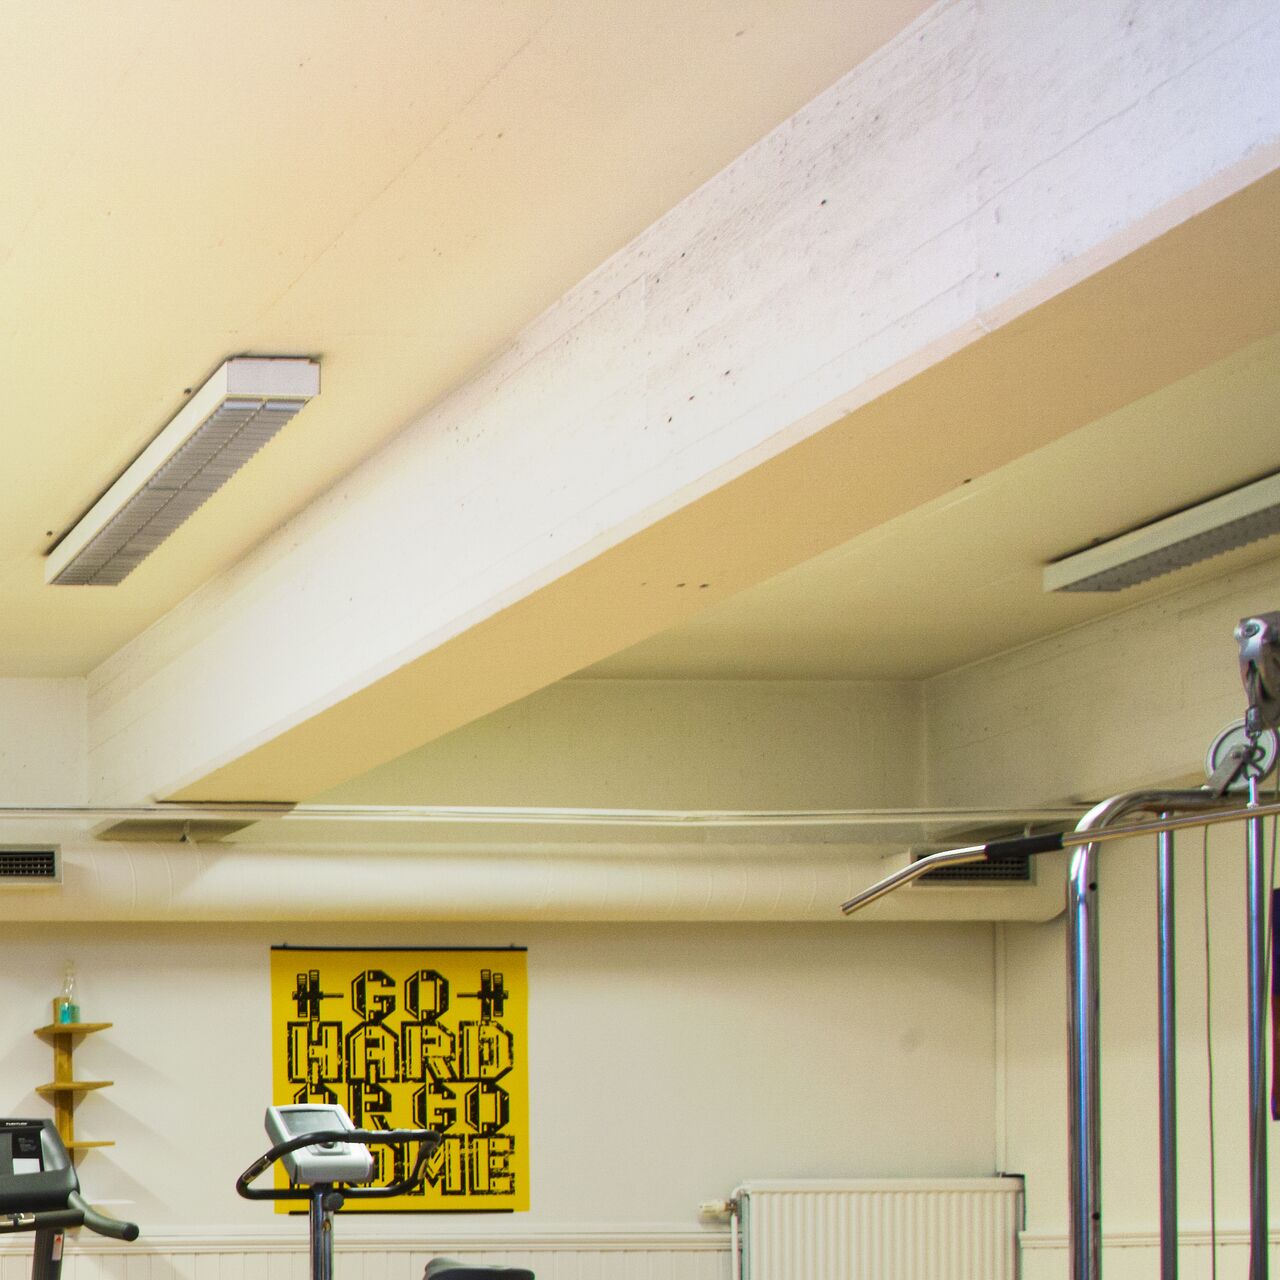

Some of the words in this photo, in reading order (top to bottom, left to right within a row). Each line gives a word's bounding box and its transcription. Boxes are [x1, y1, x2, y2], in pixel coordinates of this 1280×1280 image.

[351, 969, 450, 1021] GO
[287, 1020, 514, 1083] HARD
[412, 1082, 510, 1134] GO
